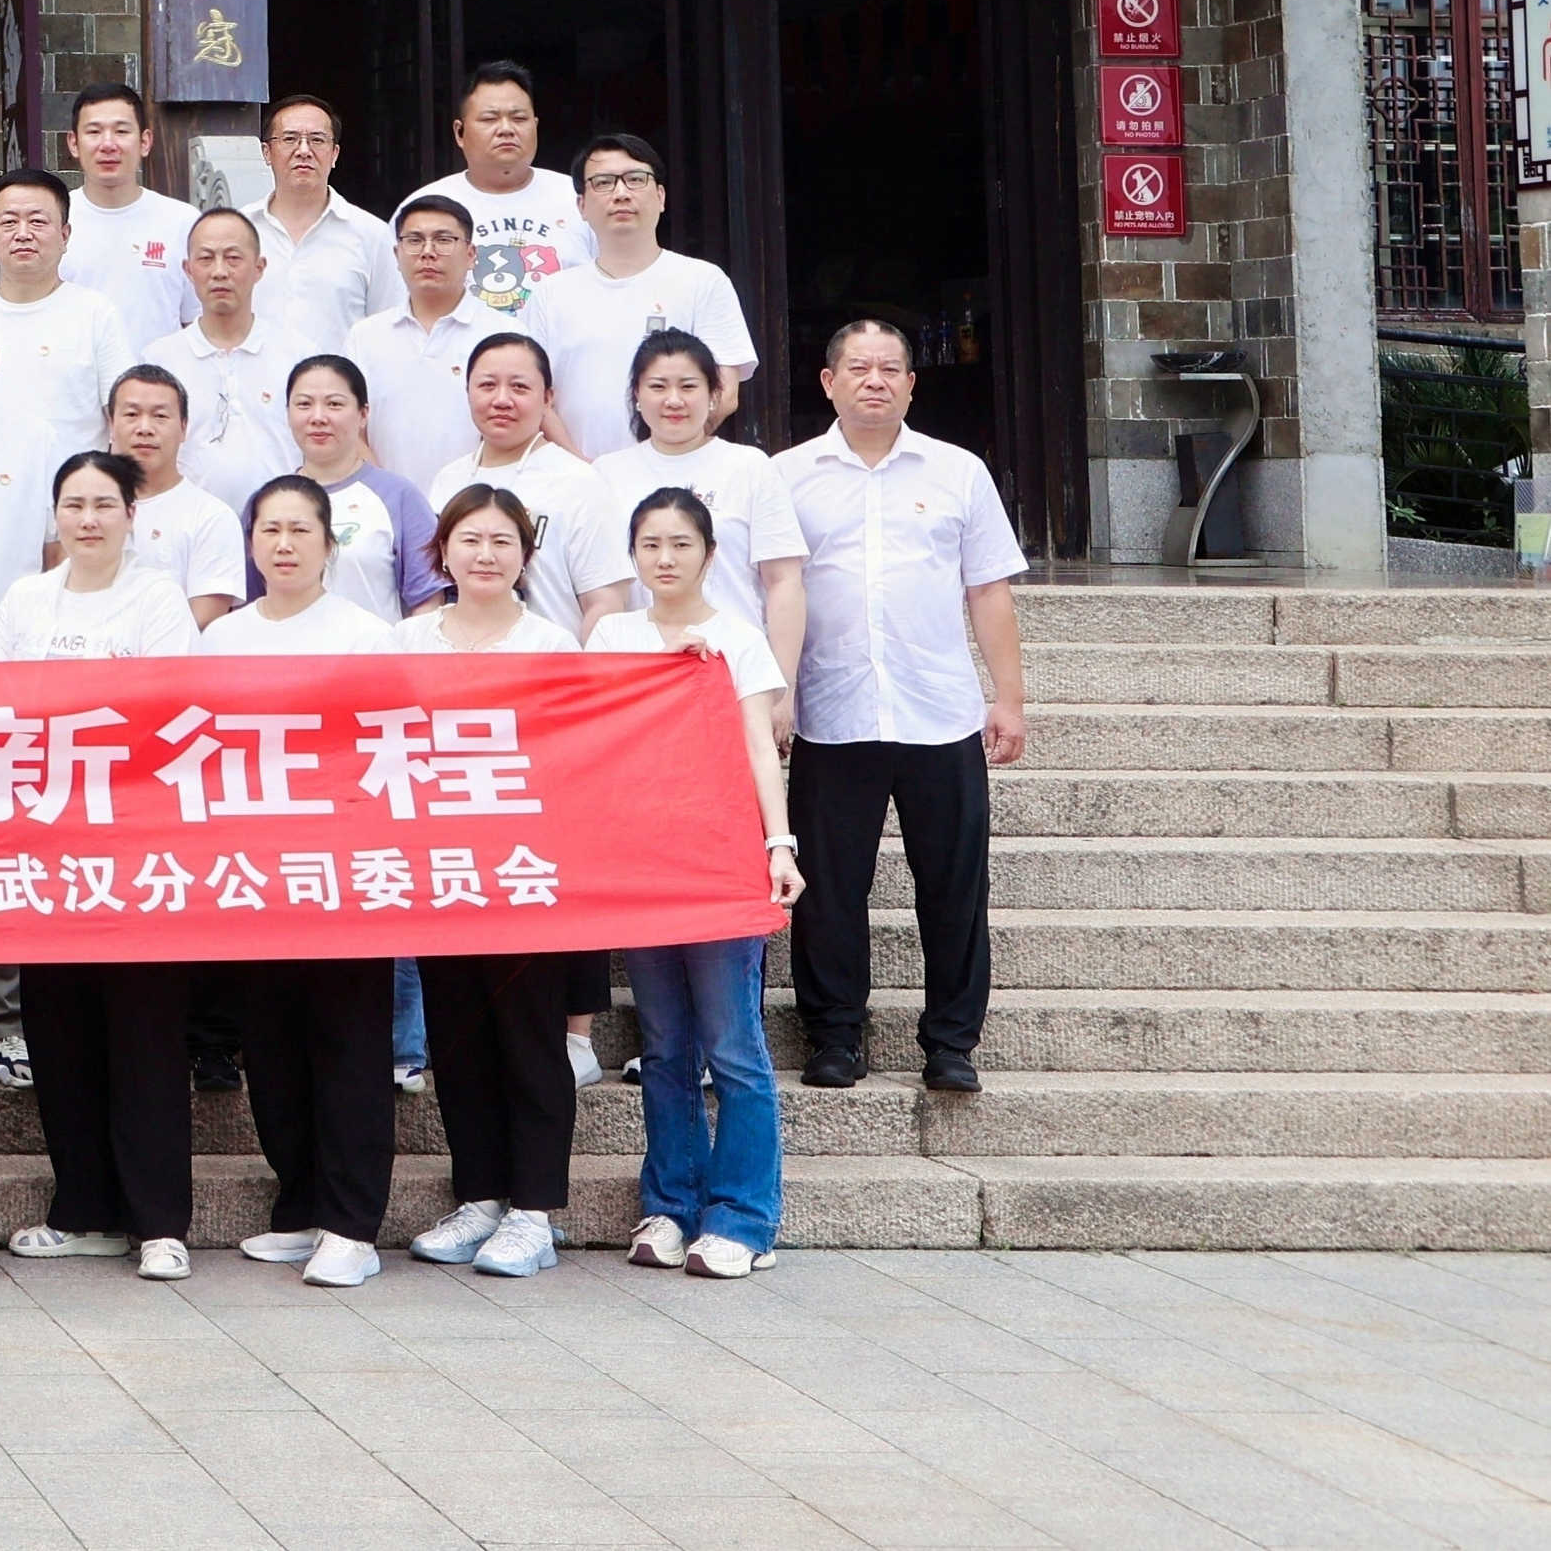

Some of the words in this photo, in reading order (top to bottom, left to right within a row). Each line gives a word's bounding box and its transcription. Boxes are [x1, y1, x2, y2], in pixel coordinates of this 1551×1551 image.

[1113, 32, 1162, 43] 禁止烟火
[1116, 120, 1164, 131] 请勿拍照
[1114, 210, 1175, 221] 禁止宠物入内
[476, 217, 550, 238] SINCE
